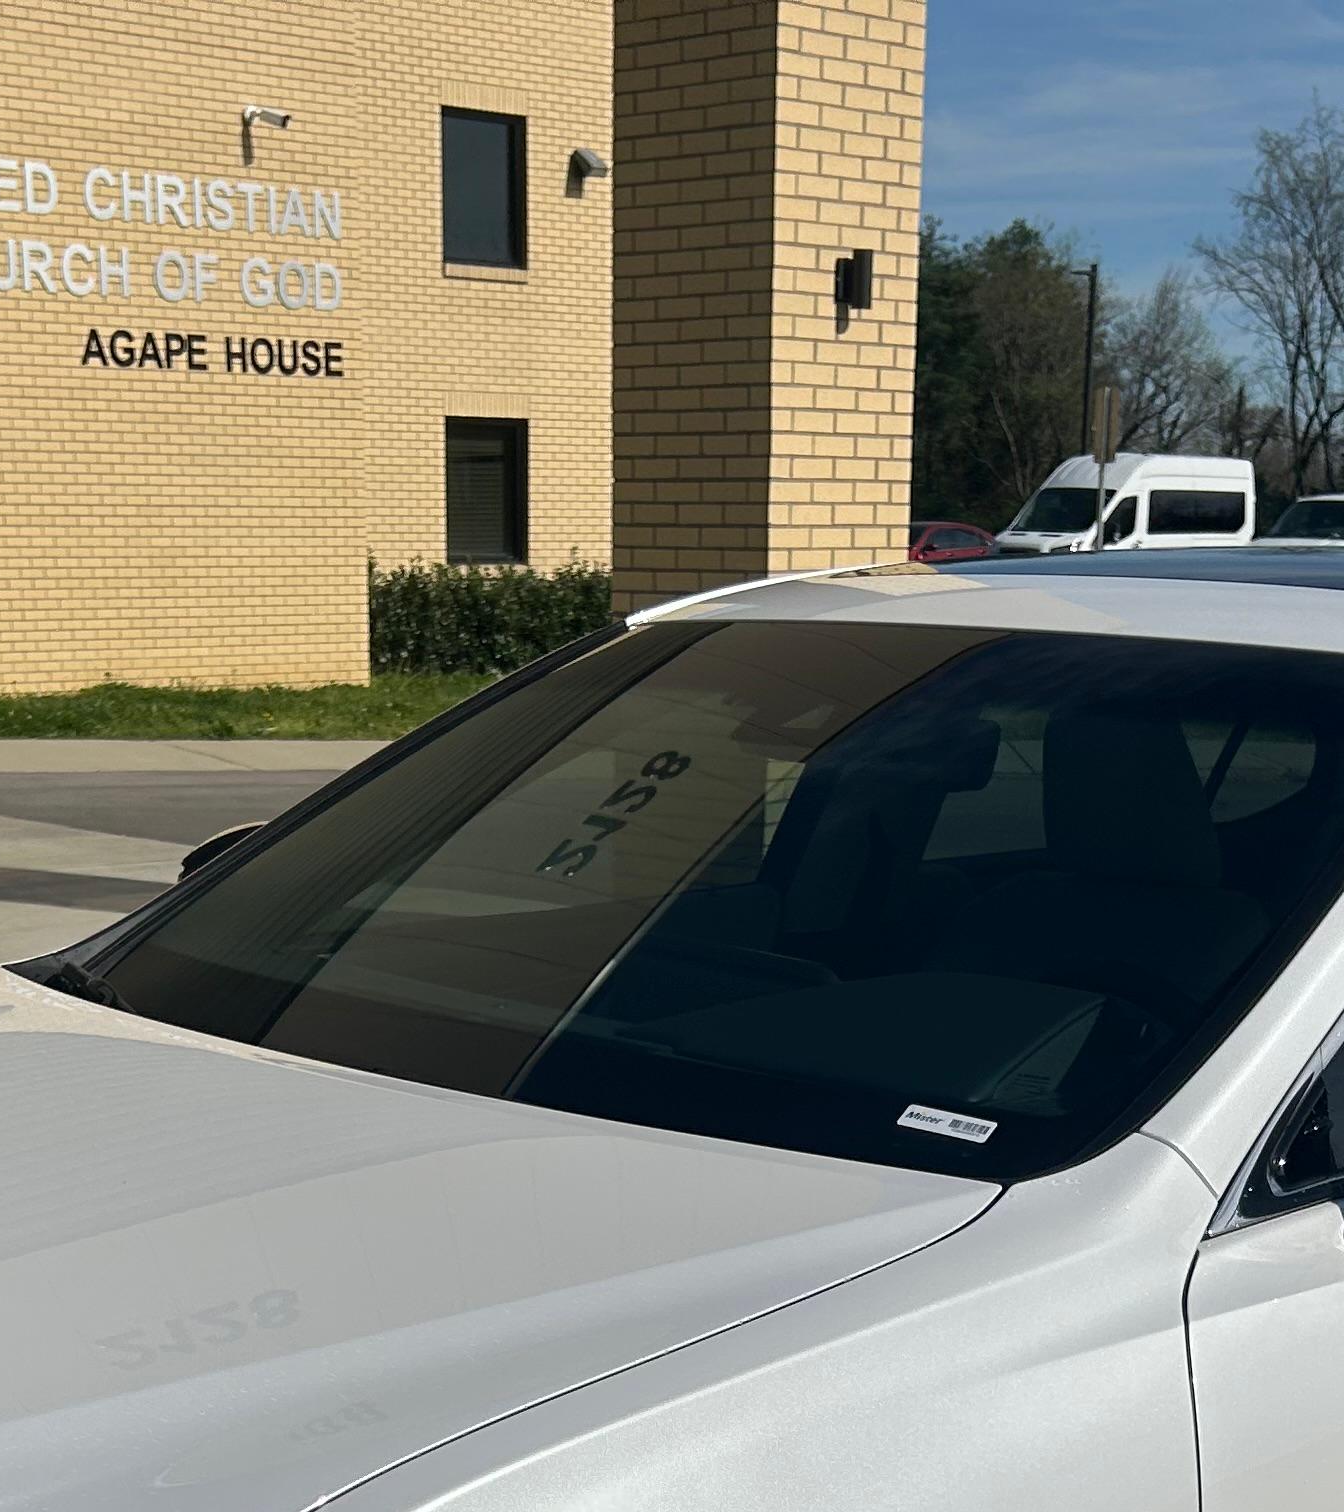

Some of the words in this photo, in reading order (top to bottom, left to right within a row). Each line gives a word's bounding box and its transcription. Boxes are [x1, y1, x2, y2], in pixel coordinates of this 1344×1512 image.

[84, 166, 343, 240] CHRISTIAN
[156, 251, 218, 301] OF
[241, 257, 343, 311] GOD
[82, 328, 208, 372] AGAPE
[224, 336, 344, 377] HOUSE
[906, 1112, 944, 1125] Mister
